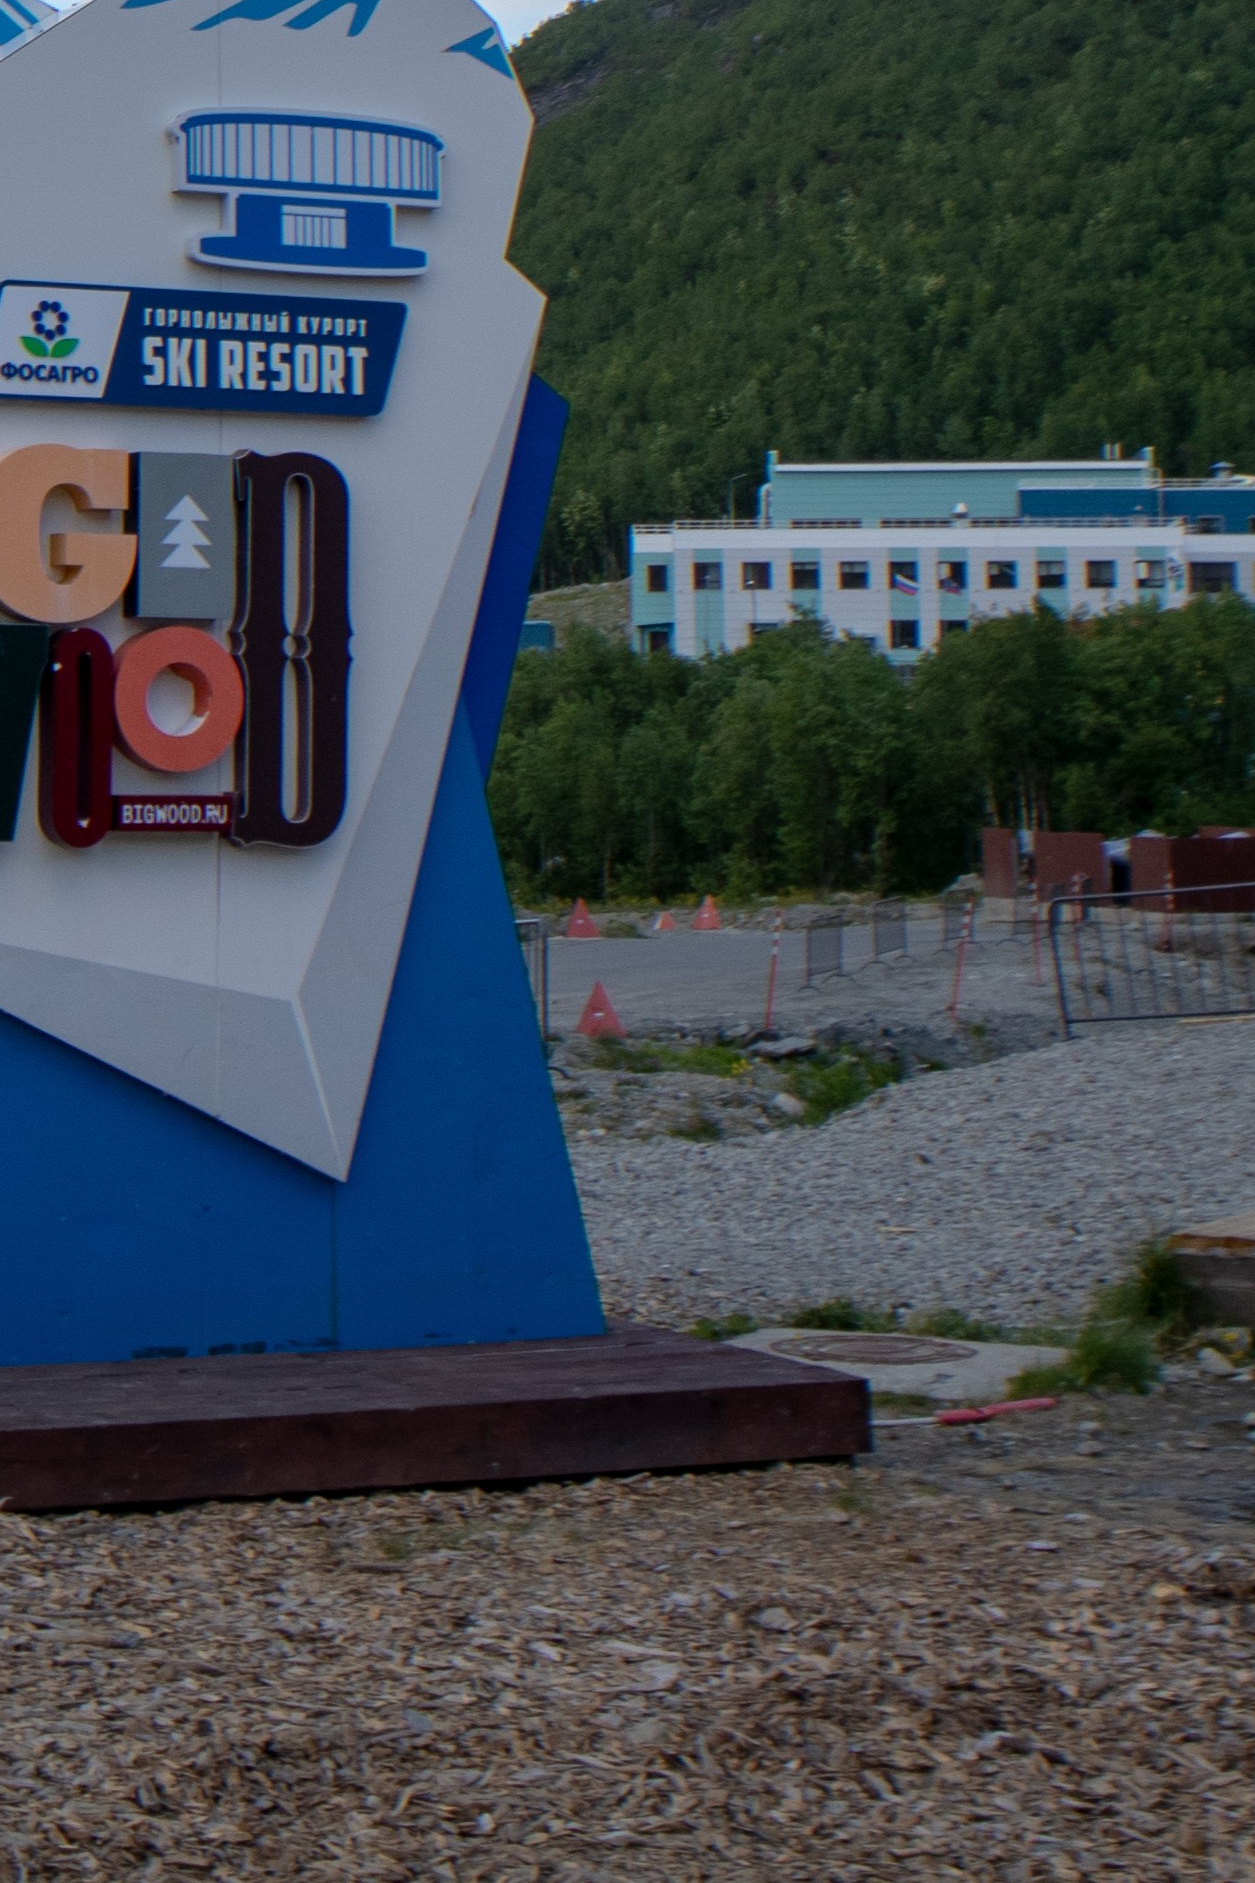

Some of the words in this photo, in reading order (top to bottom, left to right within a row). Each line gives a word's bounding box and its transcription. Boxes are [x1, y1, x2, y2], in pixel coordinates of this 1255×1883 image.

[143, 307, 291, 334] ГОРНОЛЫЖНЫЙ
[296, 316, 368, 338] КУРОРТ
[0, 361, 100, 384] ФОСАГРО
[141, 336, 208, 388] SKI
[217, 339, 369, 396] RESORT
[121, 803, 229, 825] BIGWOOD.RU
